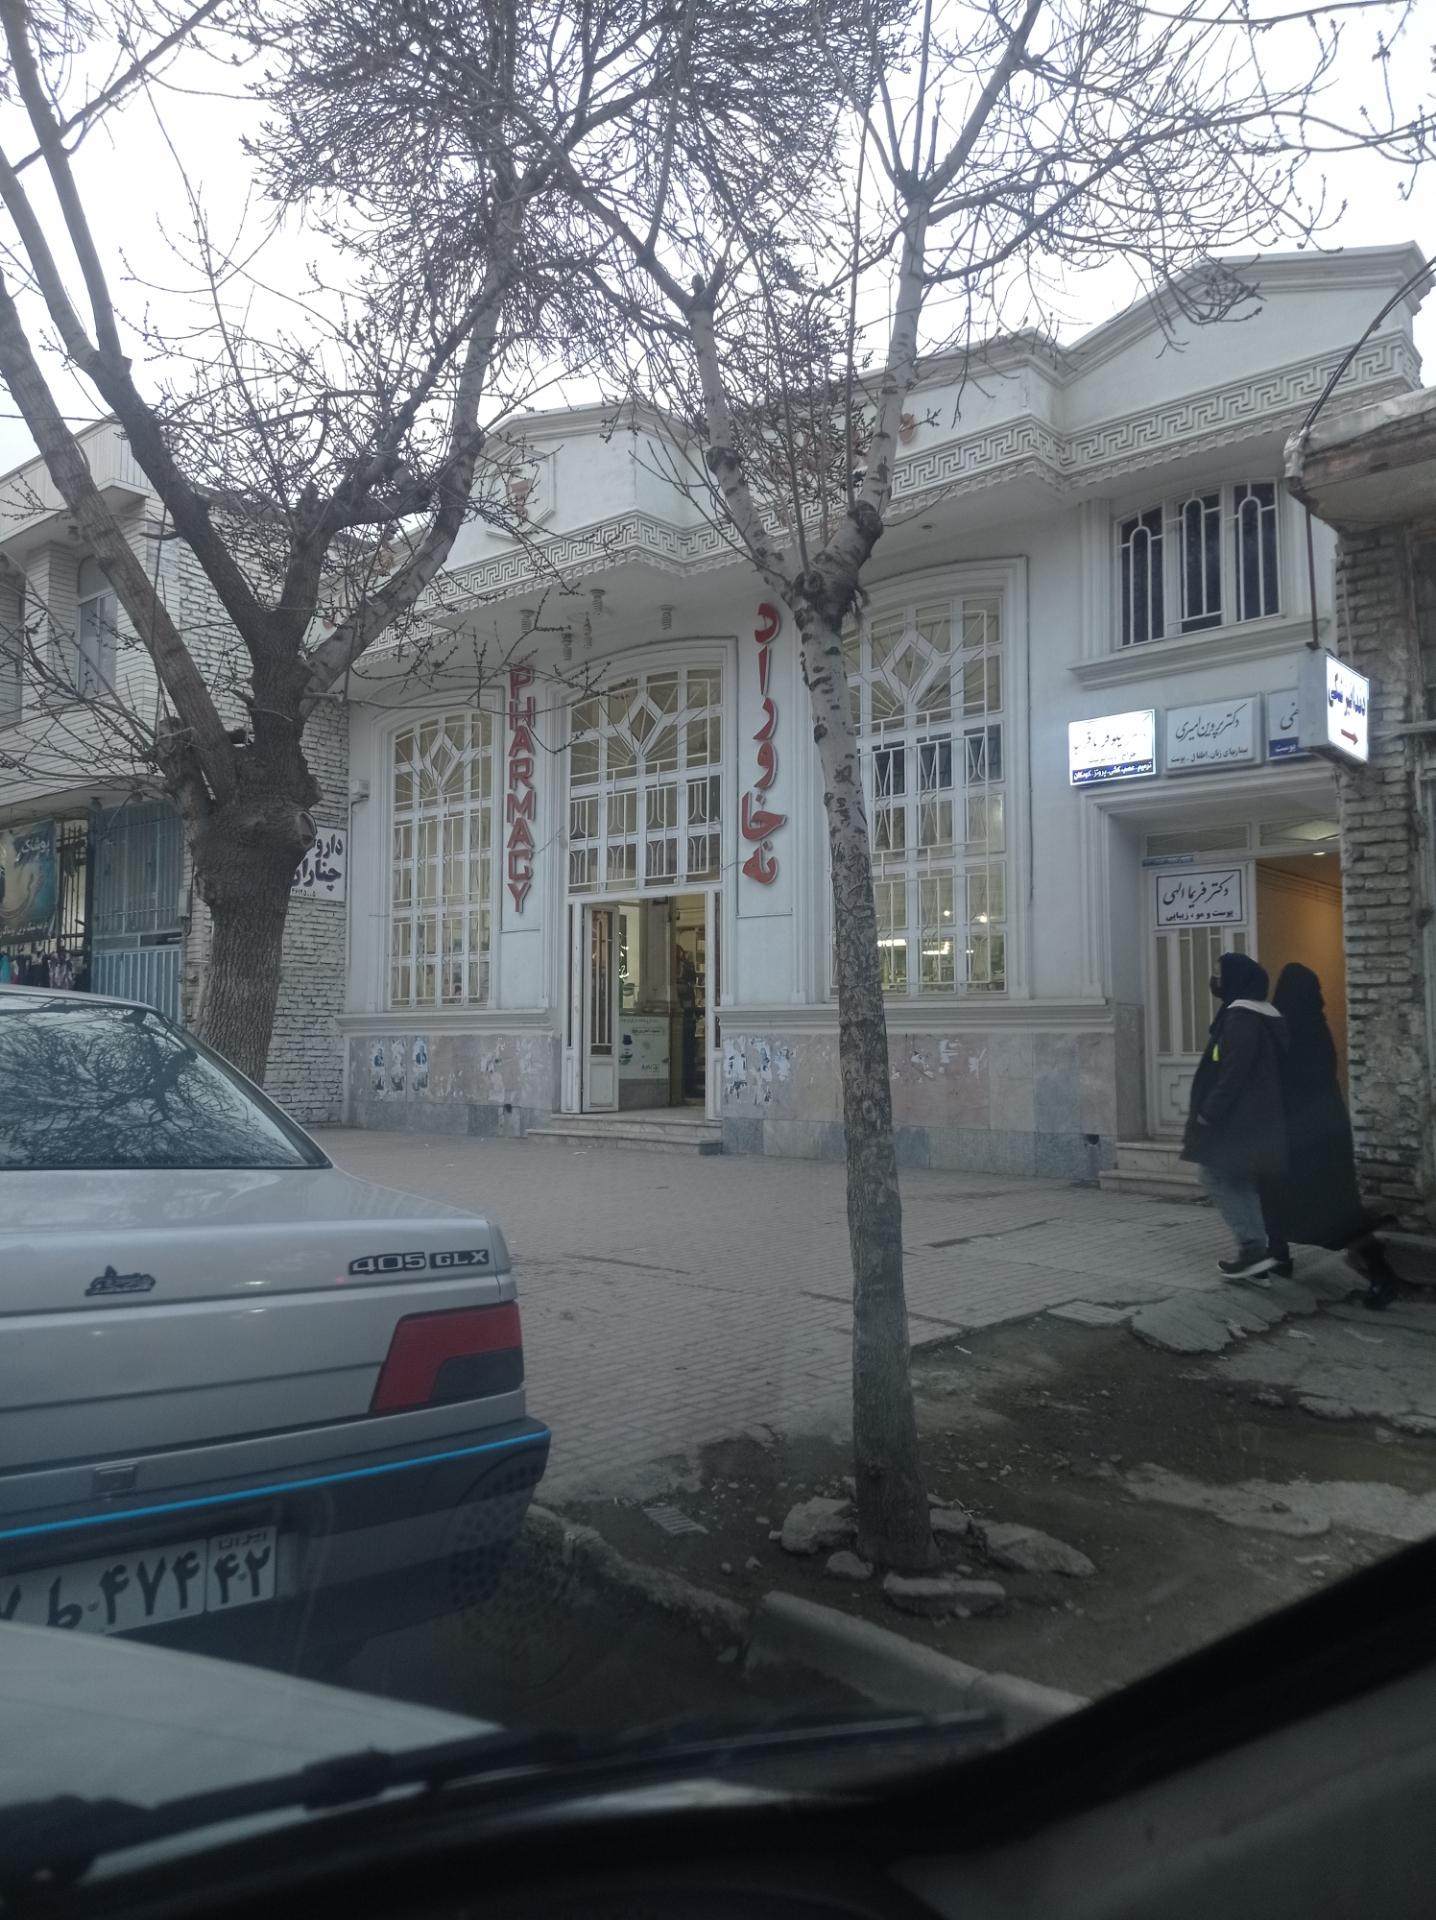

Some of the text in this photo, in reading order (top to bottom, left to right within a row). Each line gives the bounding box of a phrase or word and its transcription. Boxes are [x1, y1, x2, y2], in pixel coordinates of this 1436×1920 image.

[1176, 715, 1202, 742] امیری
[1197, 719, 1223, 739] پروین
[1220, 703, 1247, 734] دکتر
[741, 603, 787, 885] داروخانه
[506, 665, 536, 913] PHARMACY
[1163, 881, 1185, 905] الهی
[1204, 874, 1234, 903] دکتر
[1212, 910, 1234, 919] پوست
[351, 1249, 488, 1275] 405 GLX
[214, 1546, 271, 1604] ۴۲
